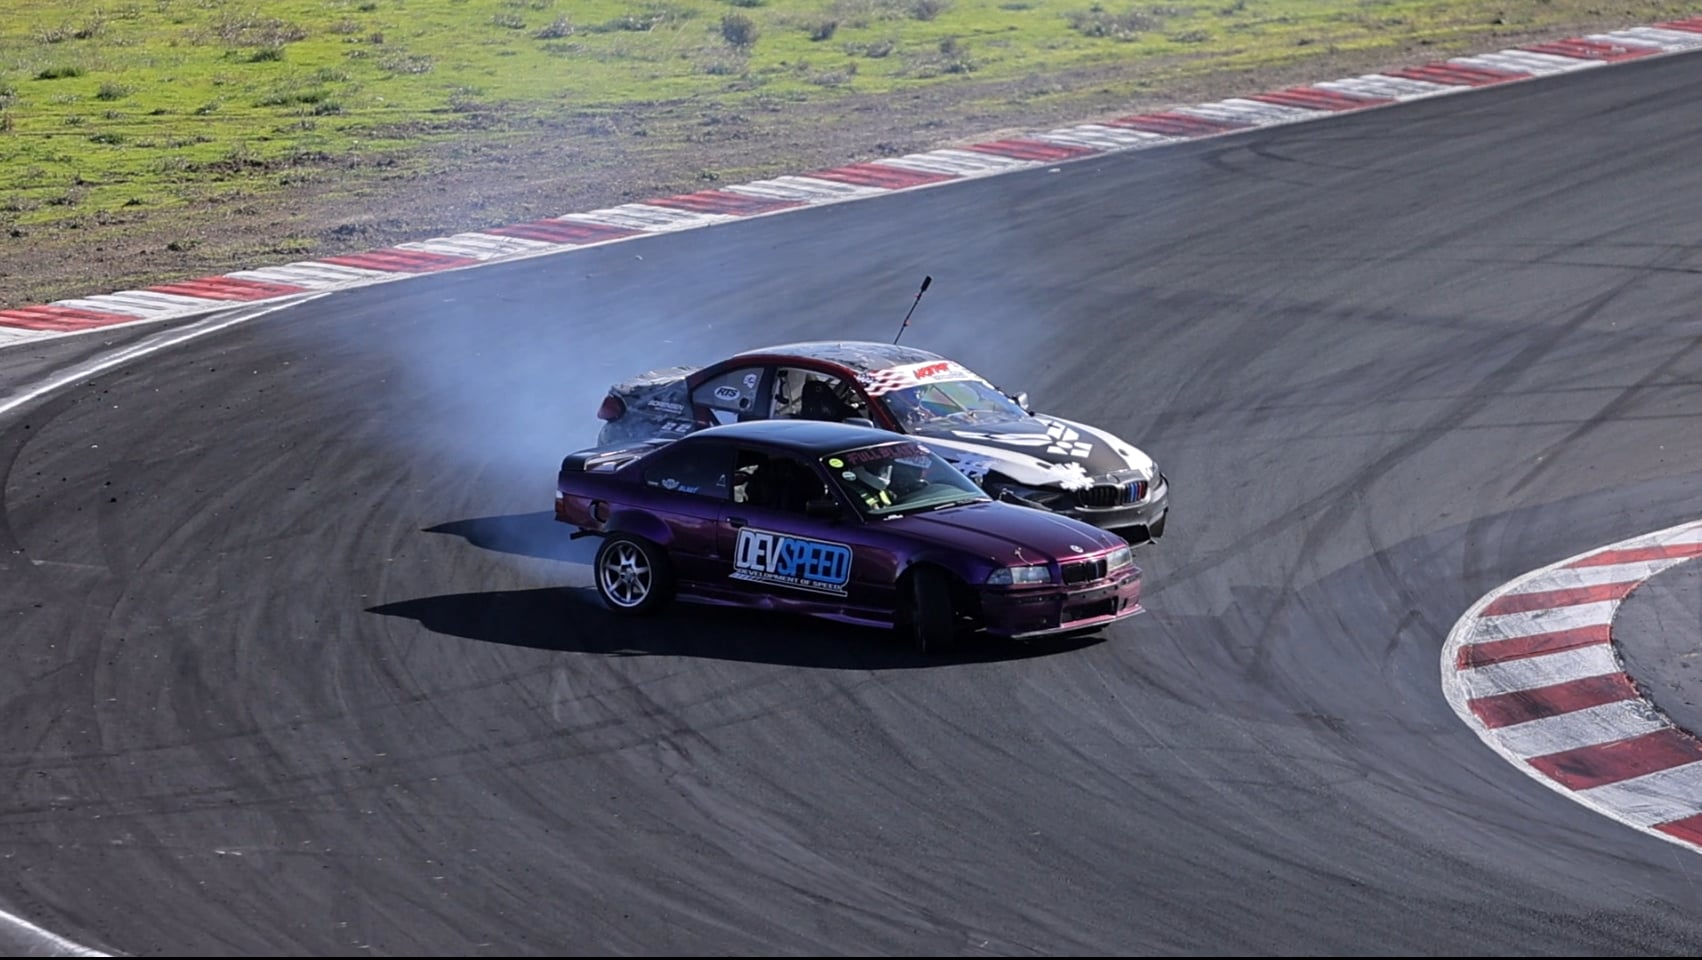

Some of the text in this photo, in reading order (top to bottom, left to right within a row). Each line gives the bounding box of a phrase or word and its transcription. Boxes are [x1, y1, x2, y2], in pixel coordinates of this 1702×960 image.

[716, 387, 738, 398] RTS
[736, 531, 849, 584] DEVSPEED
[737, 568, 799, 584] DEVELOPMENT
[813, 580, 842, 591] SPEED
